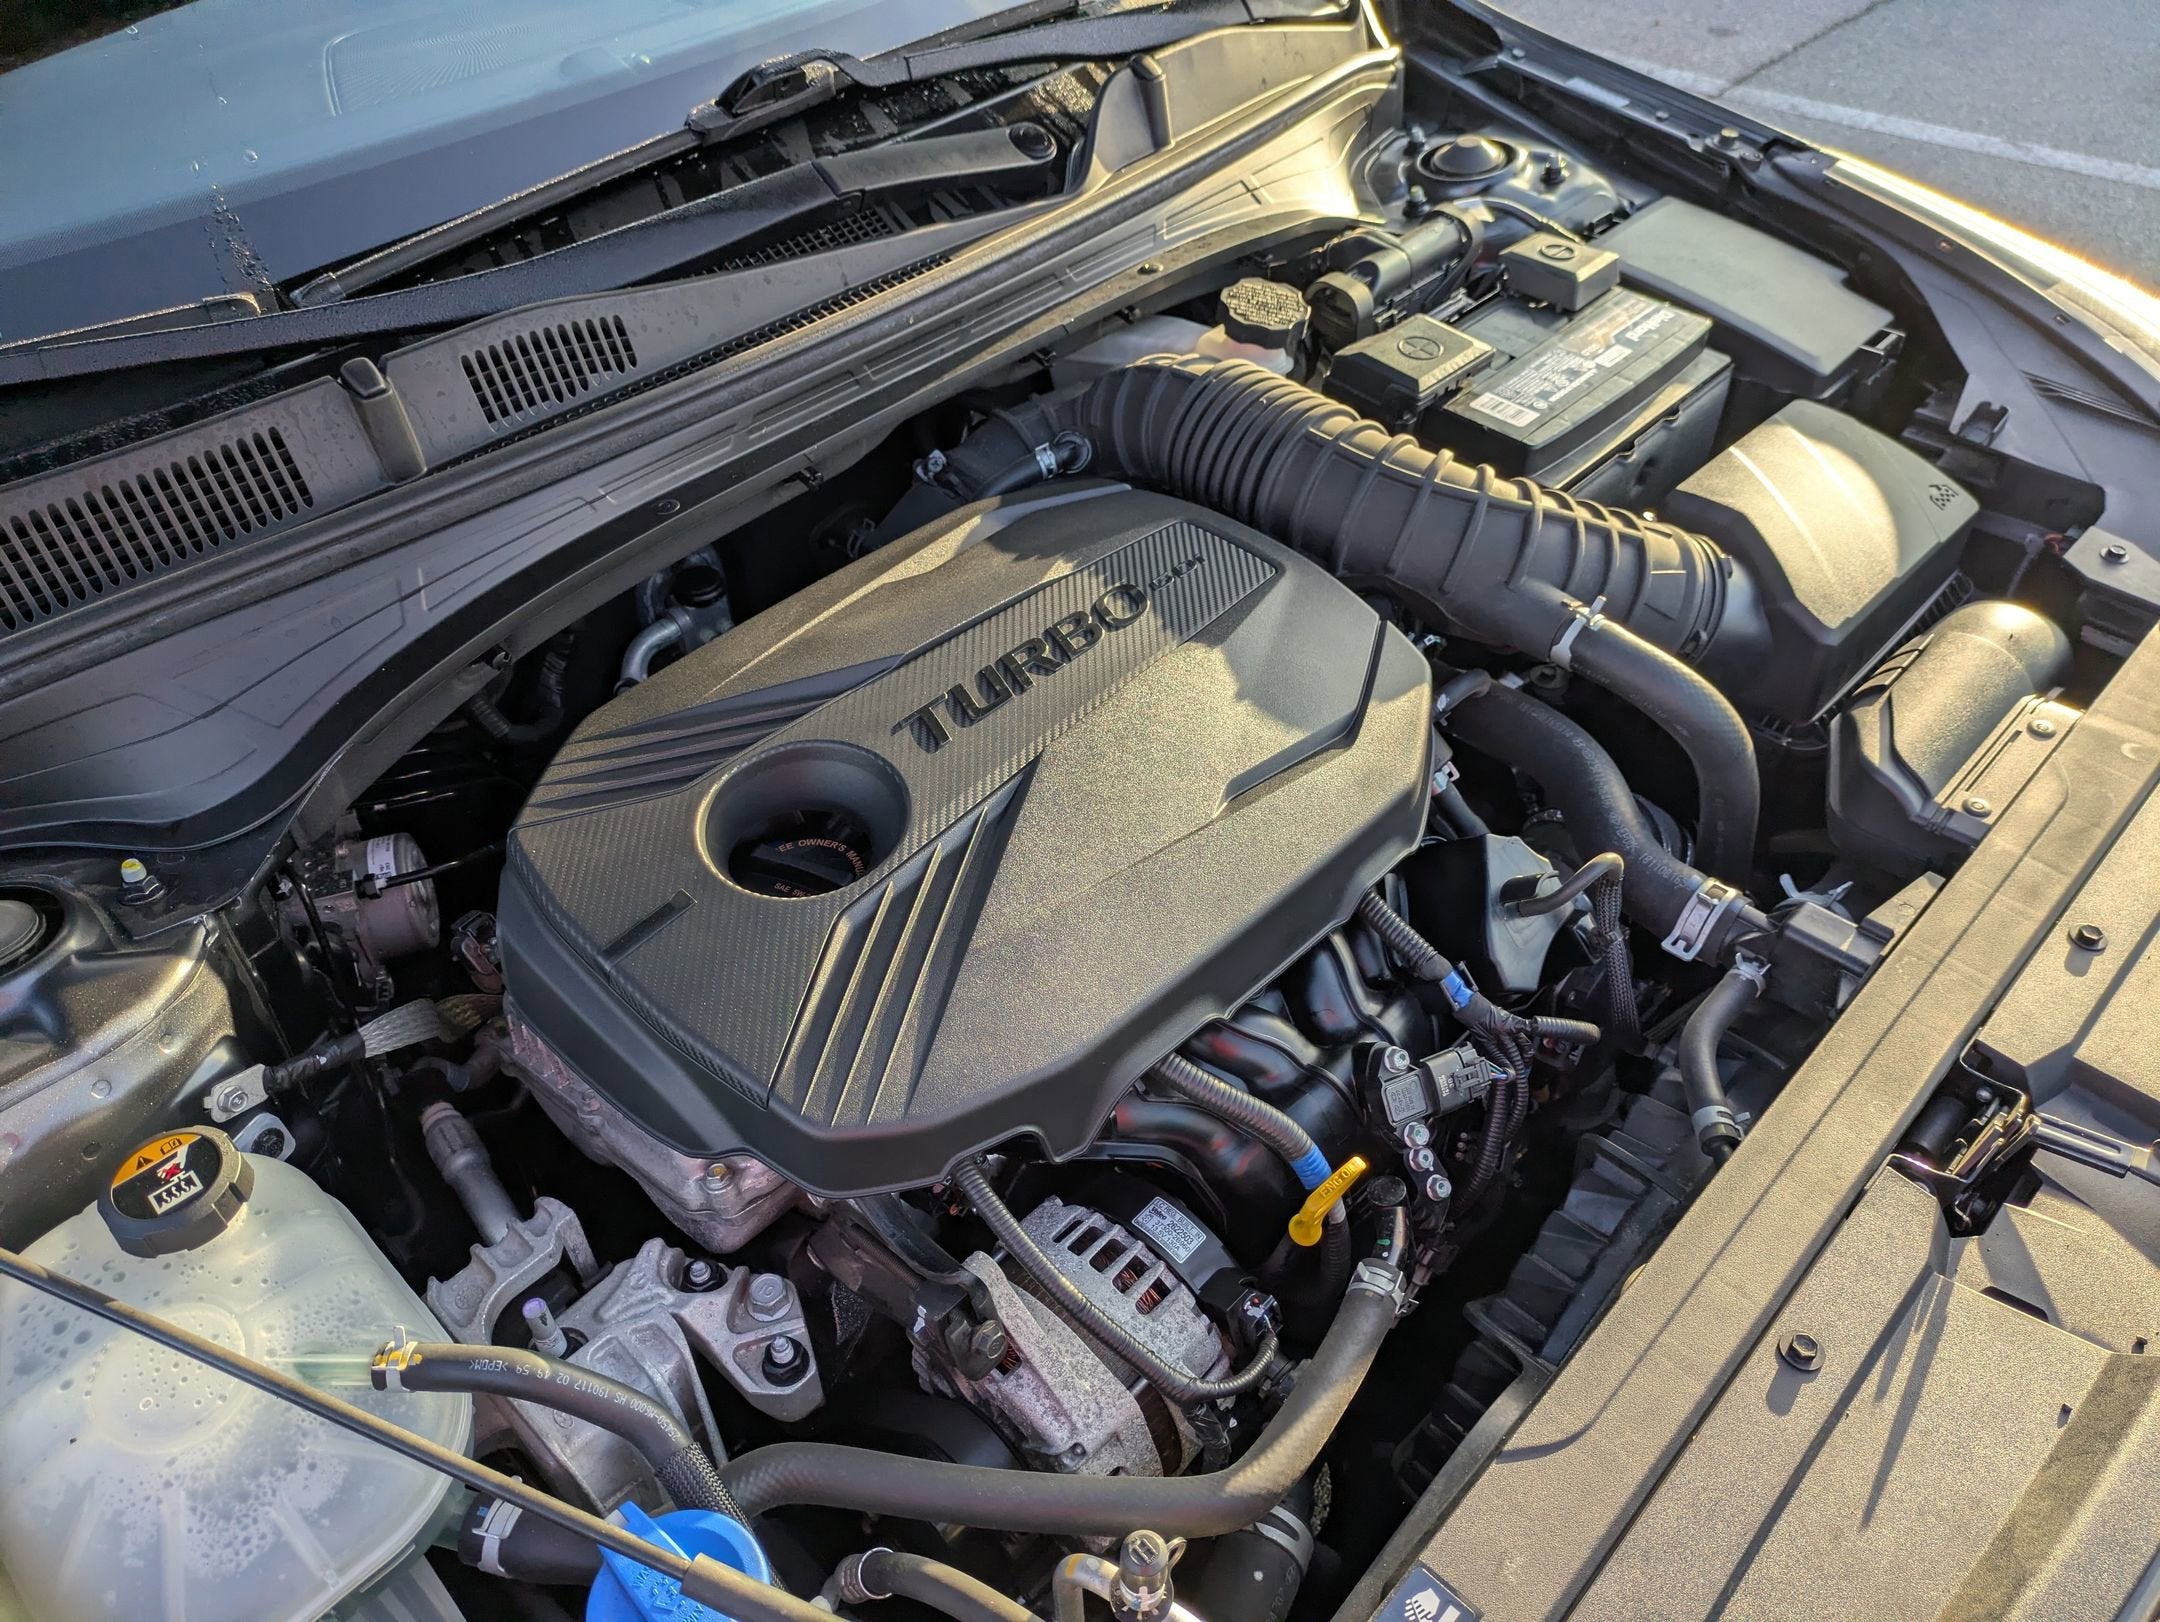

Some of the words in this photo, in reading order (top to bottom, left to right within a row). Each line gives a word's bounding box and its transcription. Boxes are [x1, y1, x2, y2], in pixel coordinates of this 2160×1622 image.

[890, 583, 1150, 747] TURBO
[775, 841, 795, 853] EE
[798, 838, 848, 852] OWNER'S
[774, 882, 792, 893] SAE
[1320, 1176, 1343, 1198] ENG
[1167, 1220, 1194, 1245] 2622503
[1178, 1216, 1194, 1232] BUILT
[556, 1372, 570, 1385] 02
[574, 1379, 610, 1398] 190117
